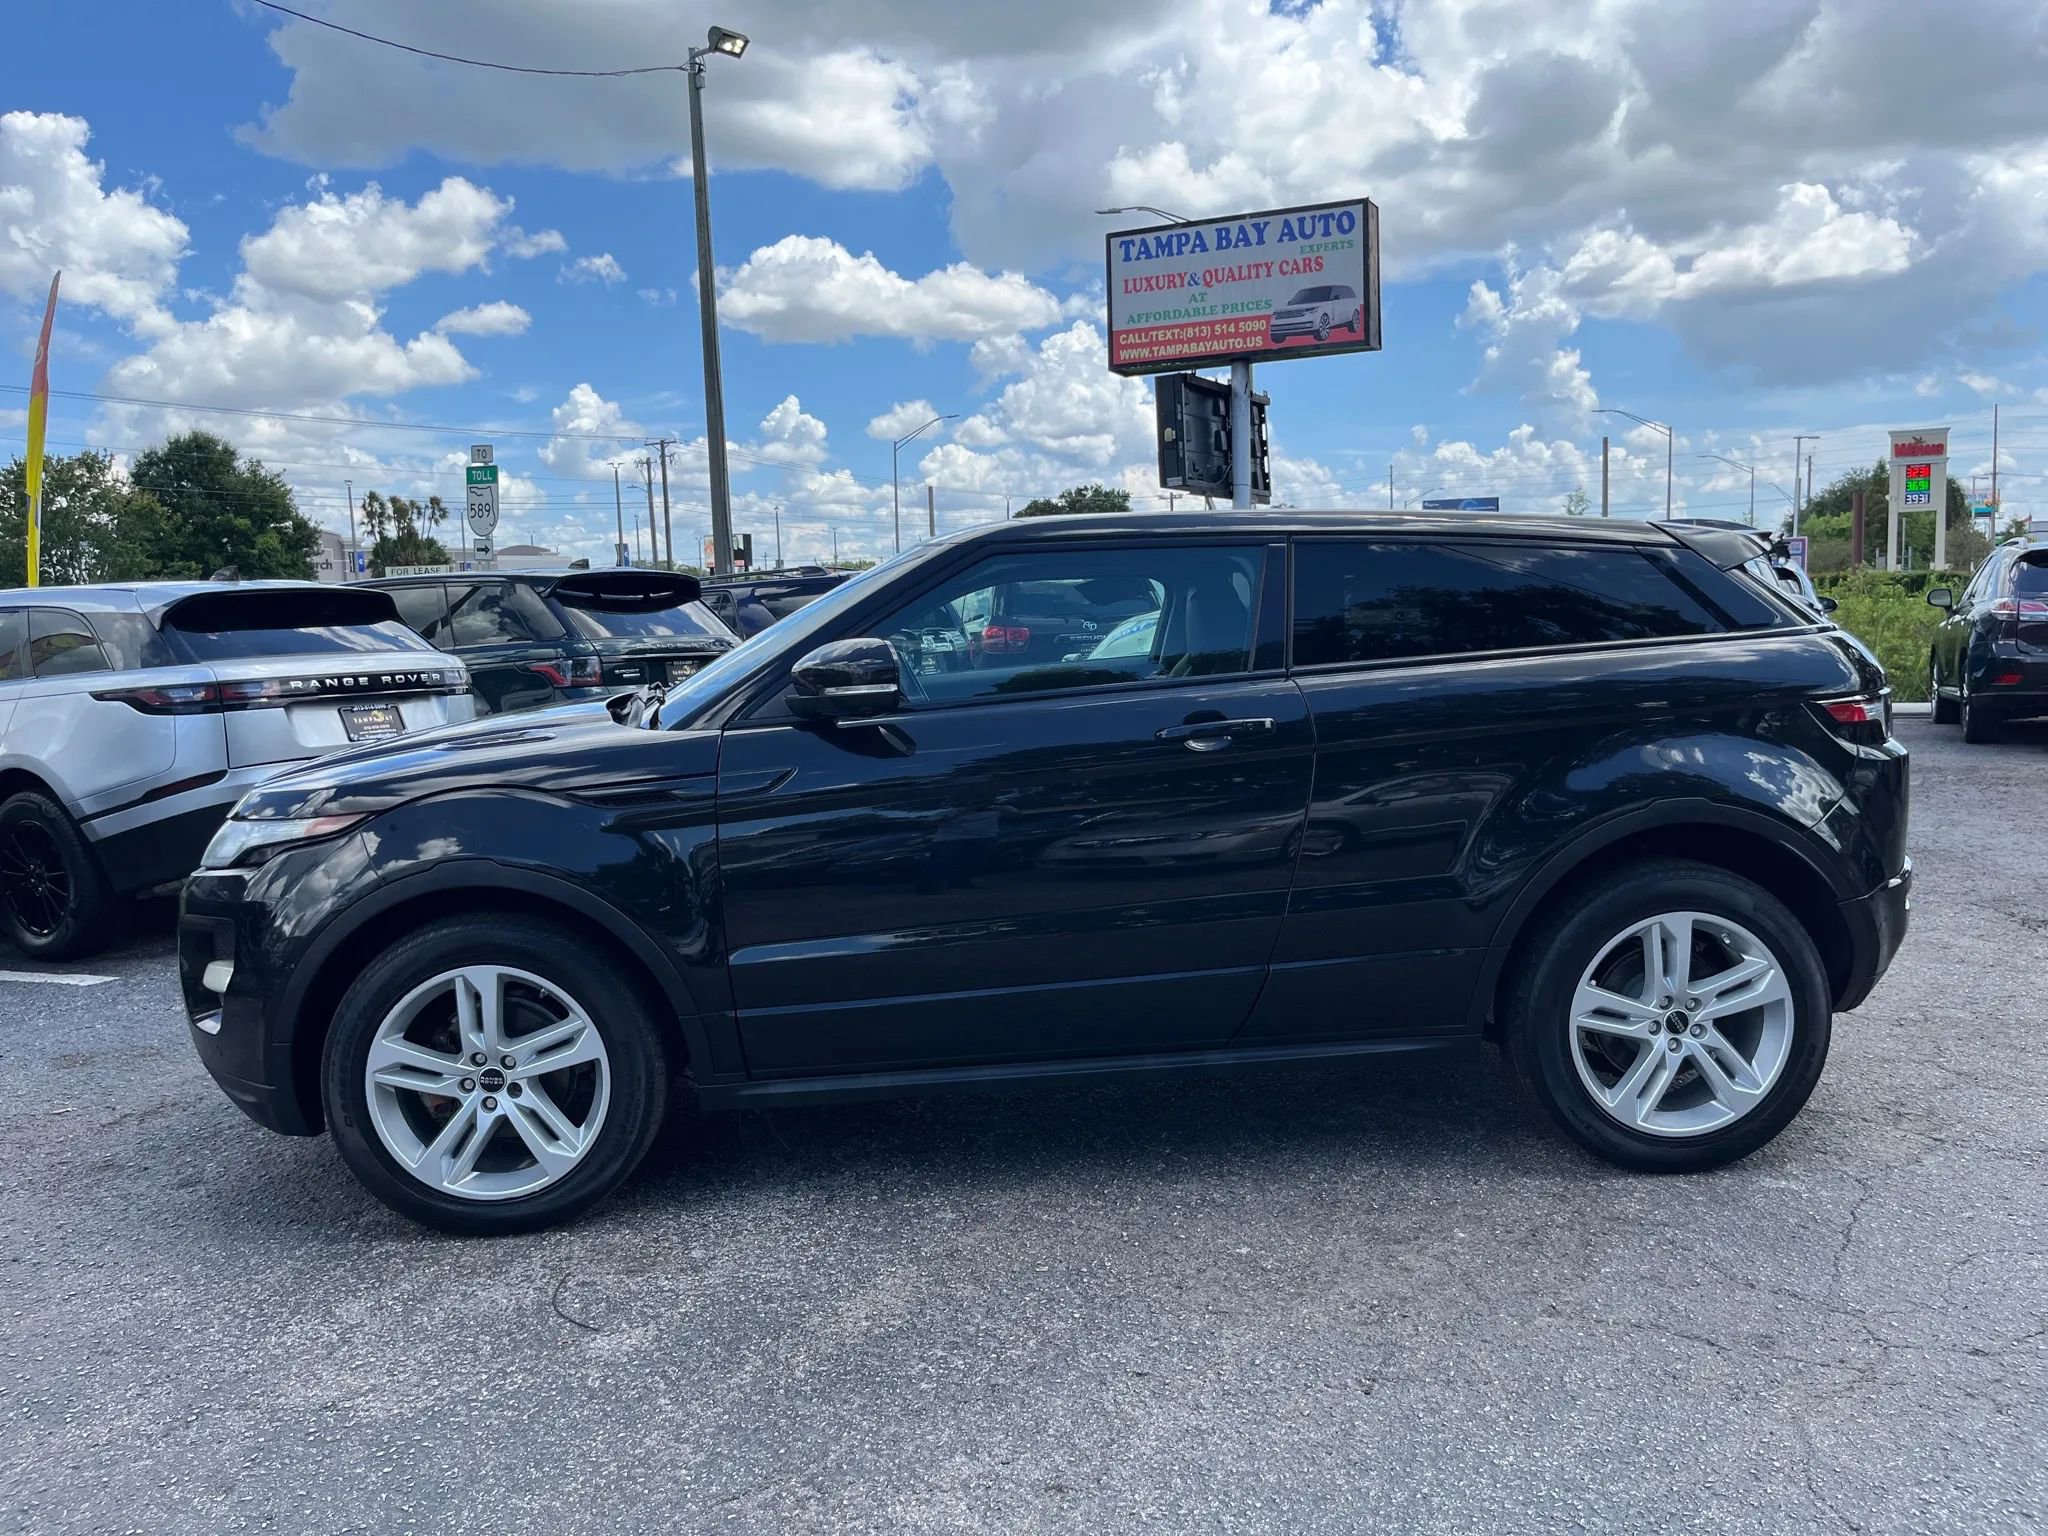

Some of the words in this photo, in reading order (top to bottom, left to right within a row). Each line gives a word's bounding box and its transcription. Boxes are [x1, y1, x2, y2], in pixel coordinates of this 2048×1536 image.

[1119, 229, 1208, 262] TAMPA
[1215, 221, 1271, 251] BAY
[1277, 211, 1356, 244] AUTO
[1300, 239, 1355, 255] EXPERTS
[1279, 256, 1324, 276] CARS
[1188, 292, 1208, 304] AT
[1126, 306, 1218, 325] AFFORDABLE
[1221, 299, 1273, 315] PRICES
[1214, 325, 1236, 335] 514
[1238, 320, 1266, 333] 5090
[1119, 336, 1263, 361] WWW.TAMPABAYAUTO.US
[476, 449, 487, 459] TO
[472, 470, 493, 480] TOLL
[470, 503, 491, 519] 589
[289, 677, 369, 689] RANGE
[381, 673, 441, 684] ROVER
